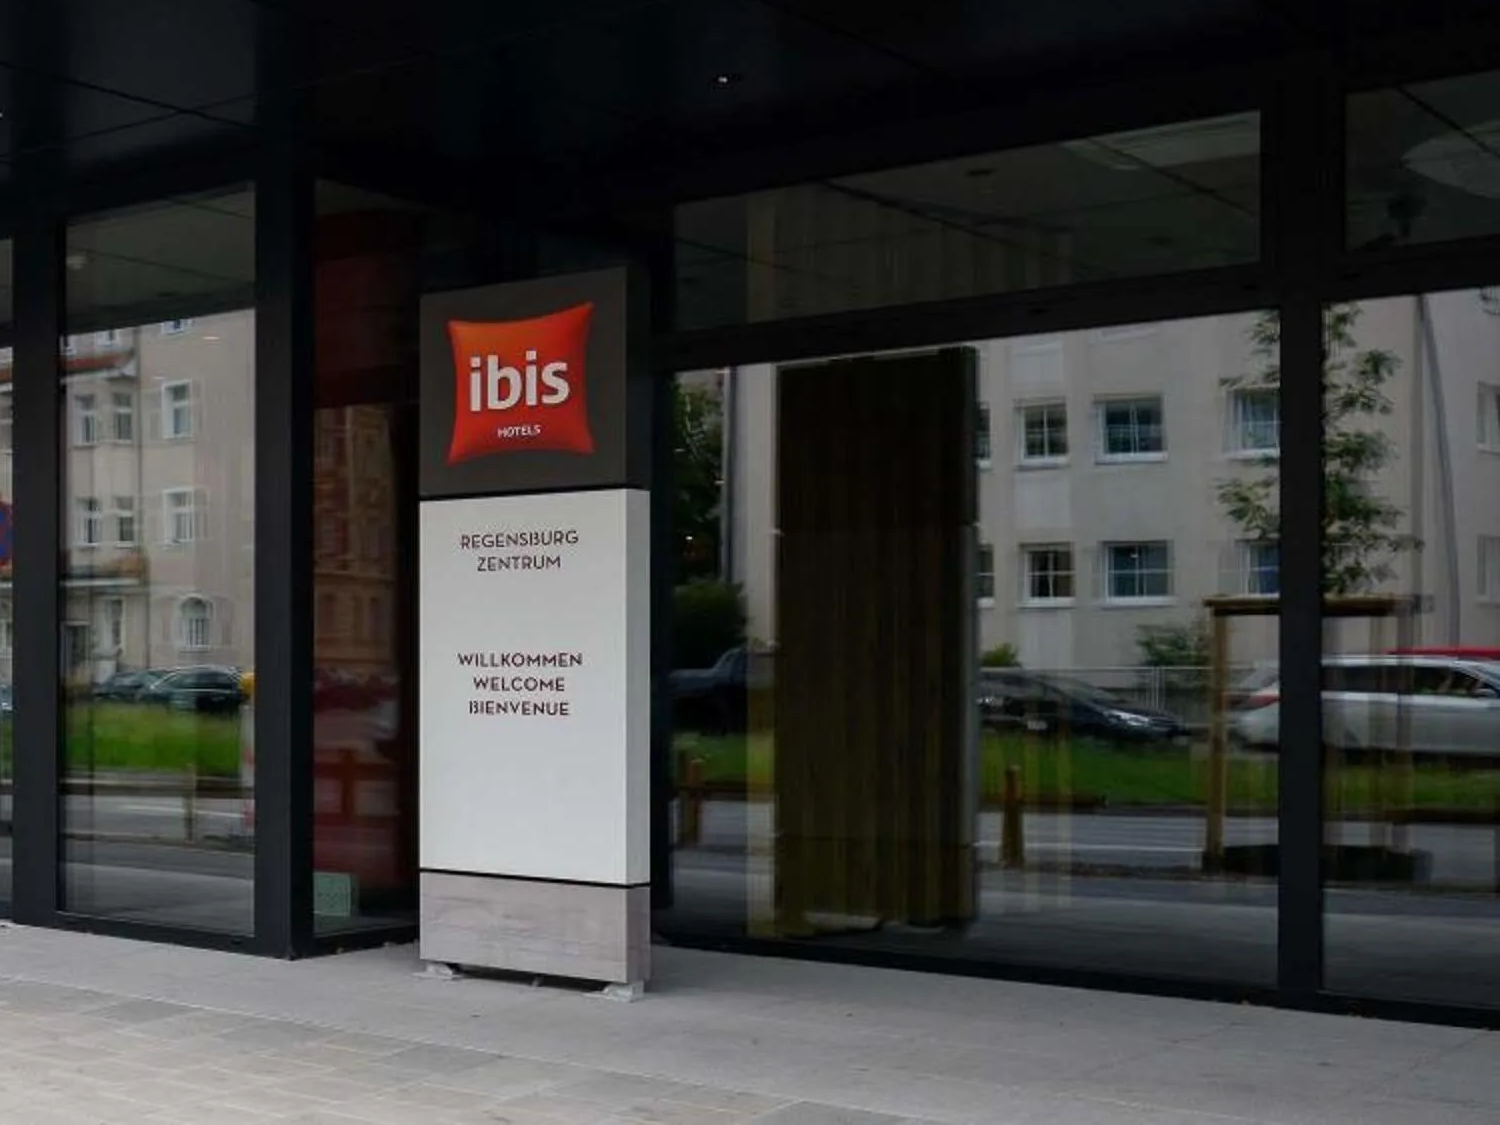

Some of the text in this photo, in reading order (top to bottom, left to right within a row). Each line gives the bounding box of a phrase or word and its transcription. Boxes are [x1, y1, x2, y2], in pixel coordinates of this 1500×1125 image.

[469, 349, 572, 413] ibis
[497, 424, 541, 439] HOTELS
[460, 530, 579, 550] REGENSBURG
[477, 555, 562, 572] ZENTRUM
[457, 652, 583, 668] WILLKOMMEN
[473, 677, 566, 692] WELCOME
[468, 701, 570, 717] BIENVENUE
